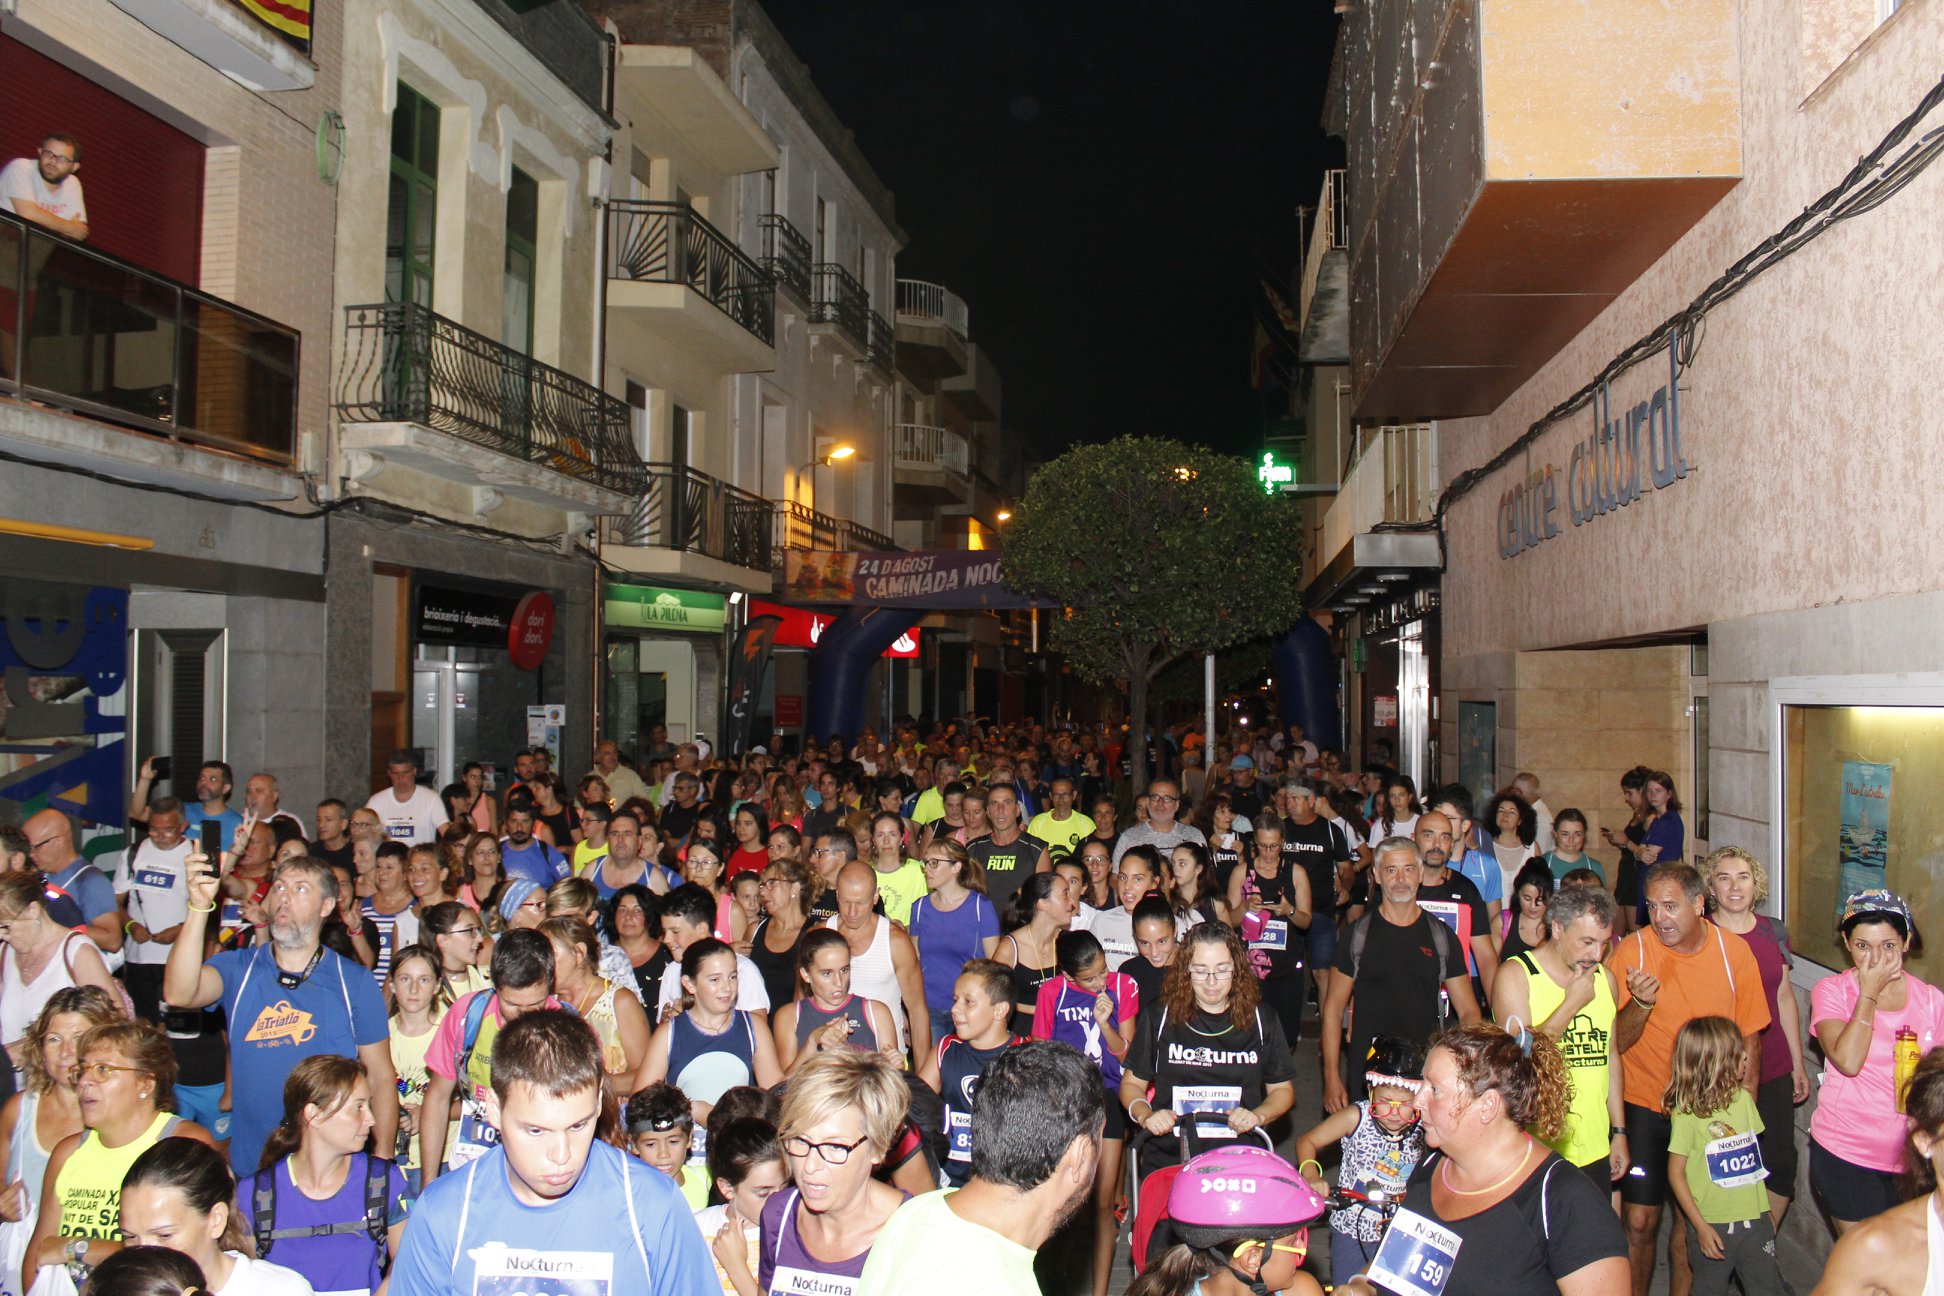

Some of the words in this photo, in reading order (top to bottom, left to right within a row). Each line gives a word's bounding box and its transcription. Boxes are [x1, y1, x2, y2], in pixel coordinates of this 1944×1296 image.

[1569, 328, 1688, 528] cultural
[859, 560, 879, 575] 24
[881, 555, 937, 575] D'AGOST
[866, 569, 958, 598] CAMINADA
[647, 606, 657, 620] LA
[987, 859, 1016, 870] RUN
[144, 874, 166, 885] 615
[1168, 1043, 1258, 1064] Nocturna
[1188, 1090, 1230, 1098] Nocturna
[1718, 1136, 1753, 1150] Nocturna
[1720, 1152, 1756, 1173] 1022
[68, 1188, 106, 1199] CAMINADA
[64, 1199, 98, 1210] POPULAR
[64, 1213, 76, 1222] NIT
[79, 1214, 94, 1224] DE
[1414, 1222, 1457, 1252] Nocturna
[506, 1256, 584, 1273] Nocturna
[1408, 1253, 1444, 1287] 159
[791, 1275, 852, 1296] Nocturna
